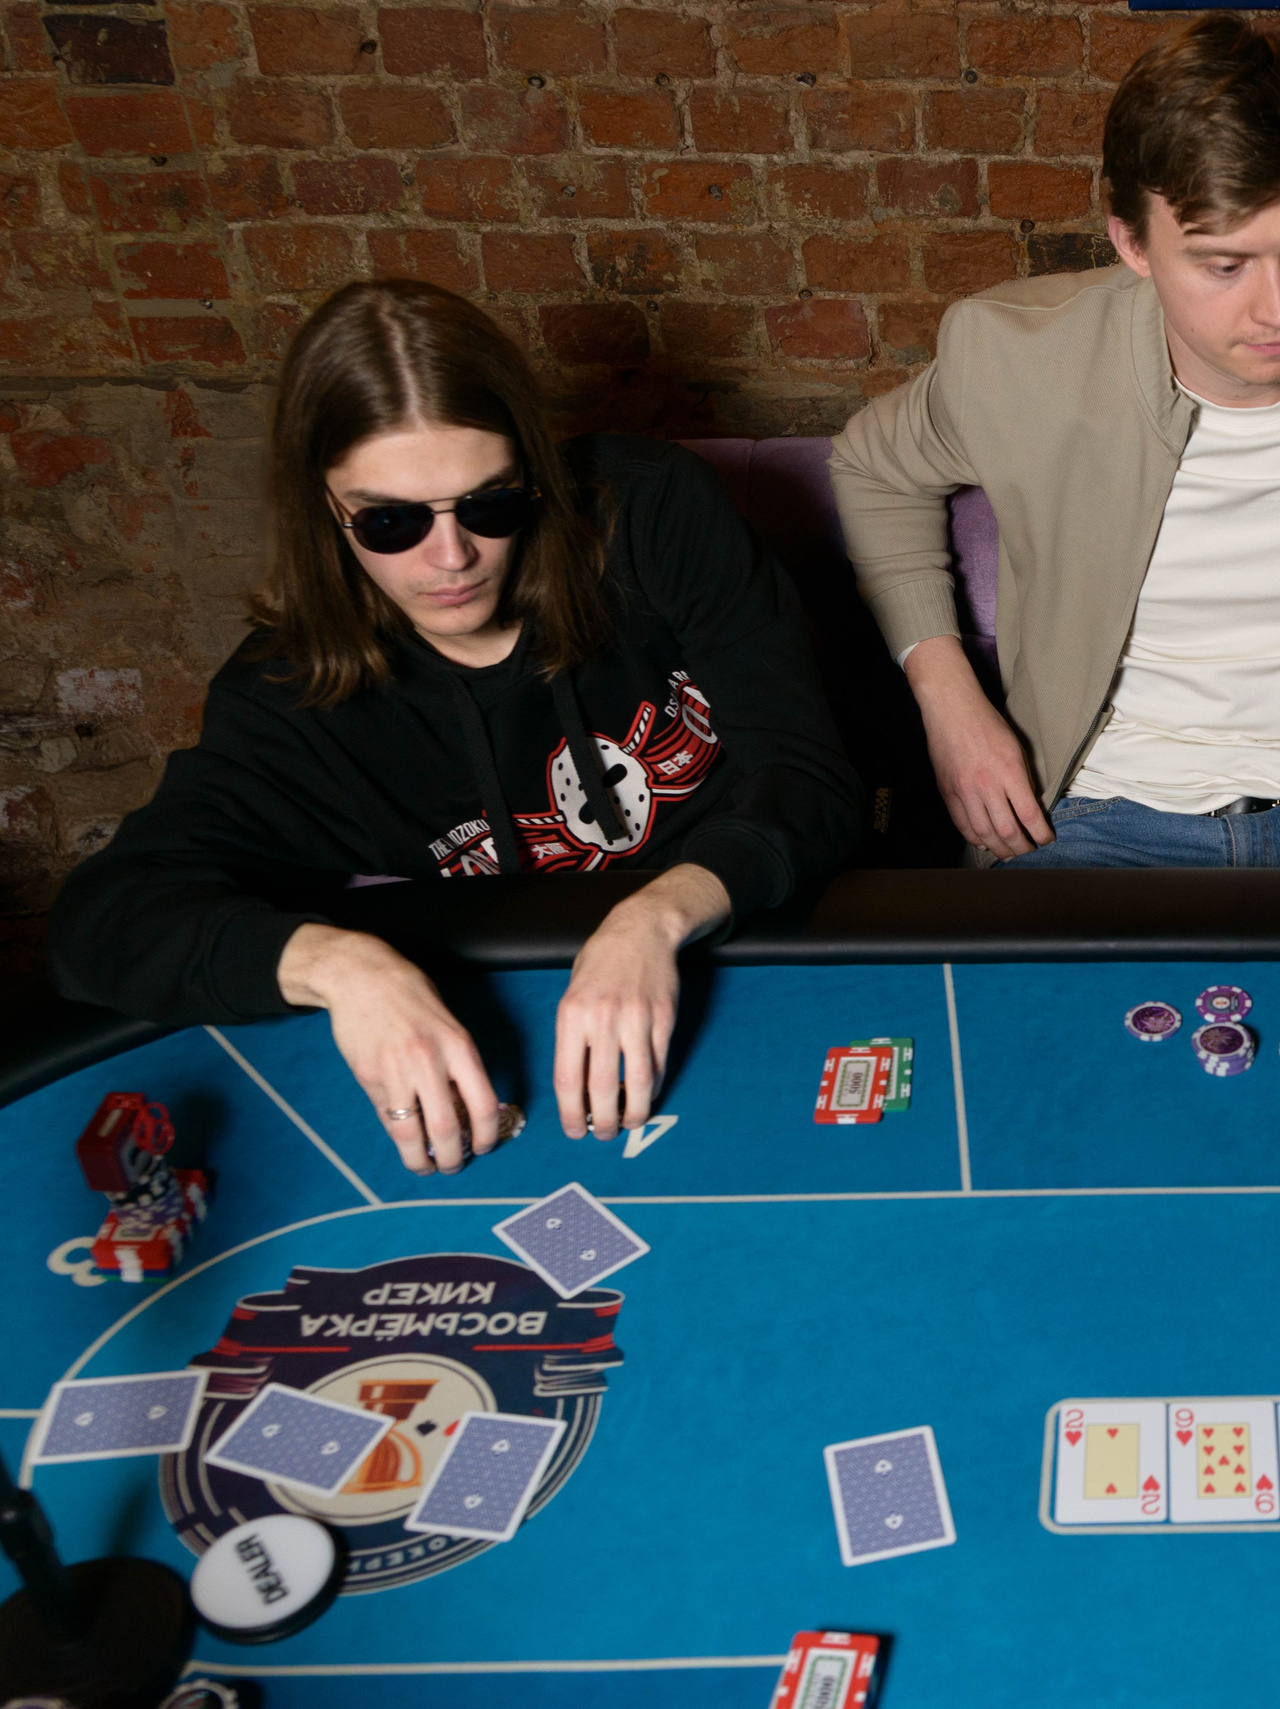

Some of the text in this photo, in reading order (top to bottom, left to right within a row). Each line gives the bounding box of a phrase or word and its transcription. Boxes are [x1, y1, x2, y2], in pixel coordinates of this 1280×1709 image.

[657, 750, 694, 776] 日本
[428, 838, 452, 860] THE
[849, 1072, 863, 1095] 5000
[362, 1281, 497, 1306] КИКЕР
[301, 1311, 548, 1341] ВОСЬМЁРКА
[1065, 1408, 1084, 1429] 2
[1175, 1408, 1195, 1428] 9
[1140, 1494, 1161, 1515] 2
[1254, 1492, 1275, 1514] 9
[349, 1534, 462, 1573] ОКЕР
[235, 1534, 289, 1606] DEALER
